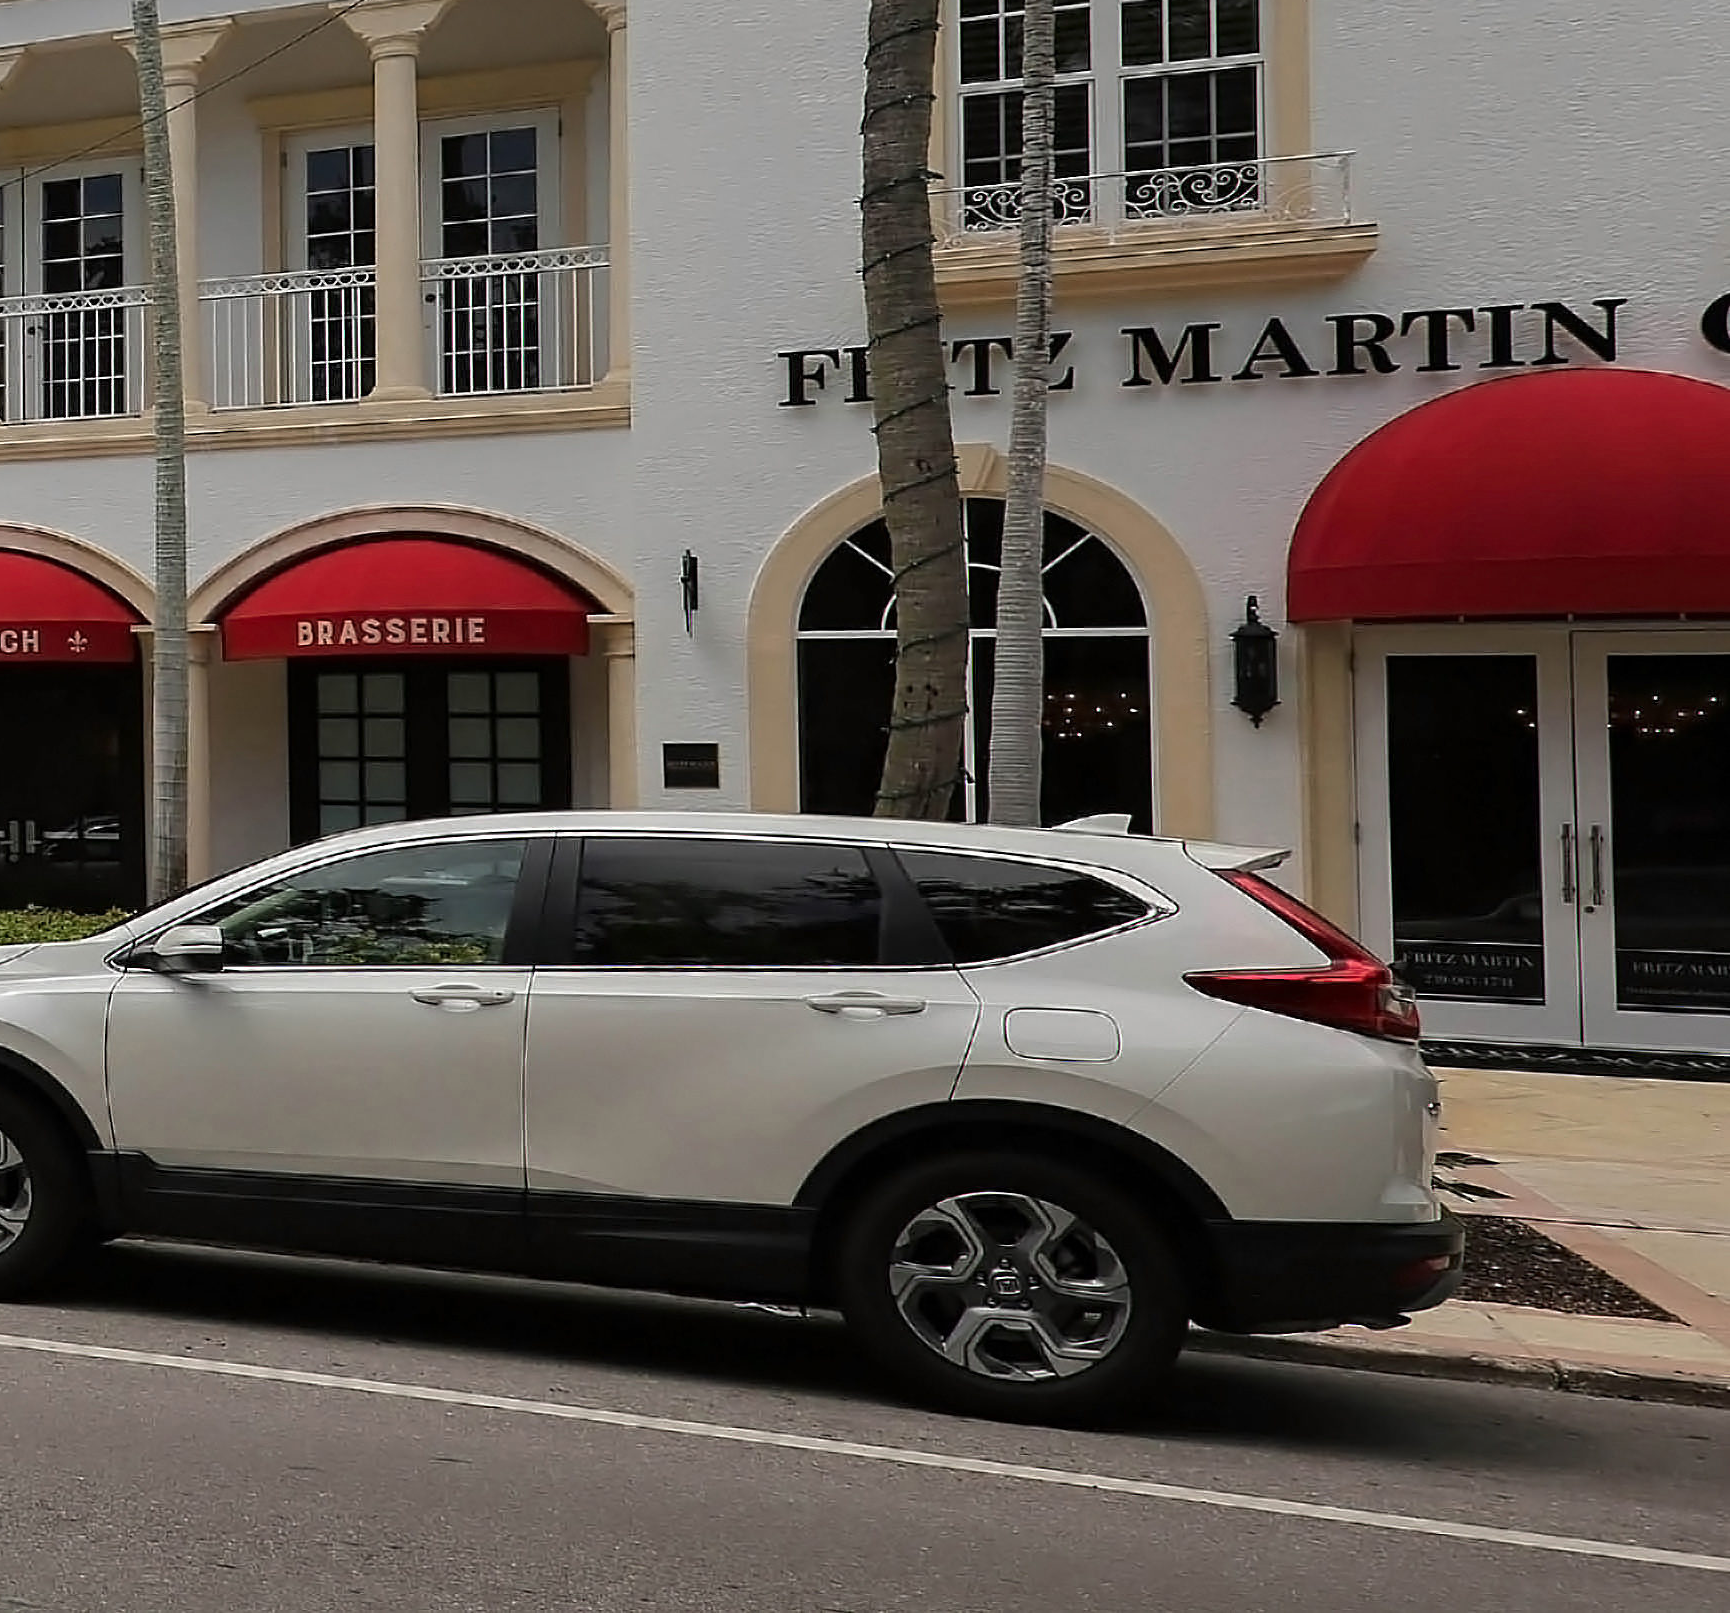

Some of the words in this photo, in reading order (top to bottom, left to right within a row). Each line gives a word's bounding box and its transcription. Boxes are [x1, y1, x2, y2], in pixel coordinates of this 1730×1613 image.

[1119, 298, 1629, 387] MARTIN
[297, 618, 486, 646] BRASSERIE
[1462, 953, 1535, 969] MARTIN
